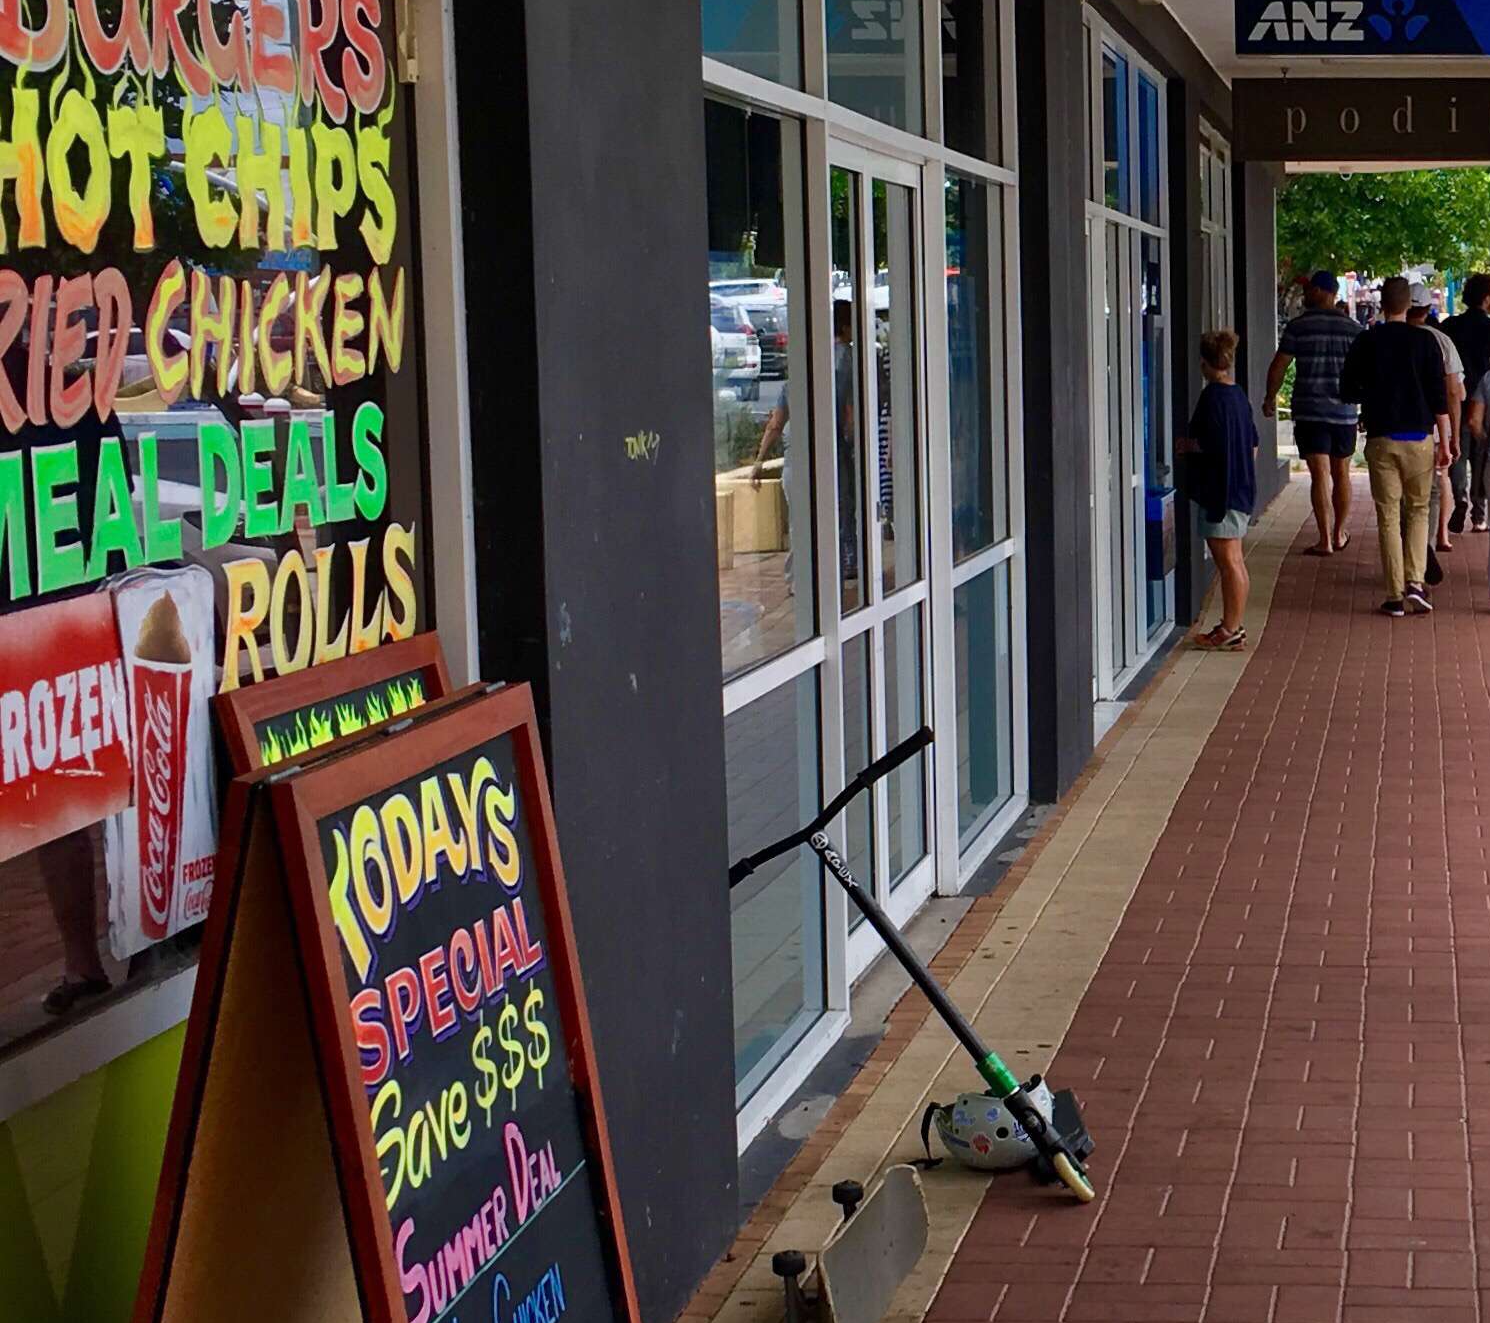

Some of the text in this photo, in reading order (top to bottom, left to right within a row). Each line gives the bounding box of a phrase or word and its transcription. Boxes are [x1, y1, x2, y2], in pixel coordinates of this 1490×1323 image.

[1247, 1, 1365, 42] ANZ
[184, 97, 398, 265] CHIPS
[147, 257, 405, 405] CHICKEN
[200, 400, 388, 552] DEALS
[219, 523, 417, 695] ROLLS
[350, 895, 545, 1087] SPECIAL
[371, 977, 550, 1213] Save $$$
